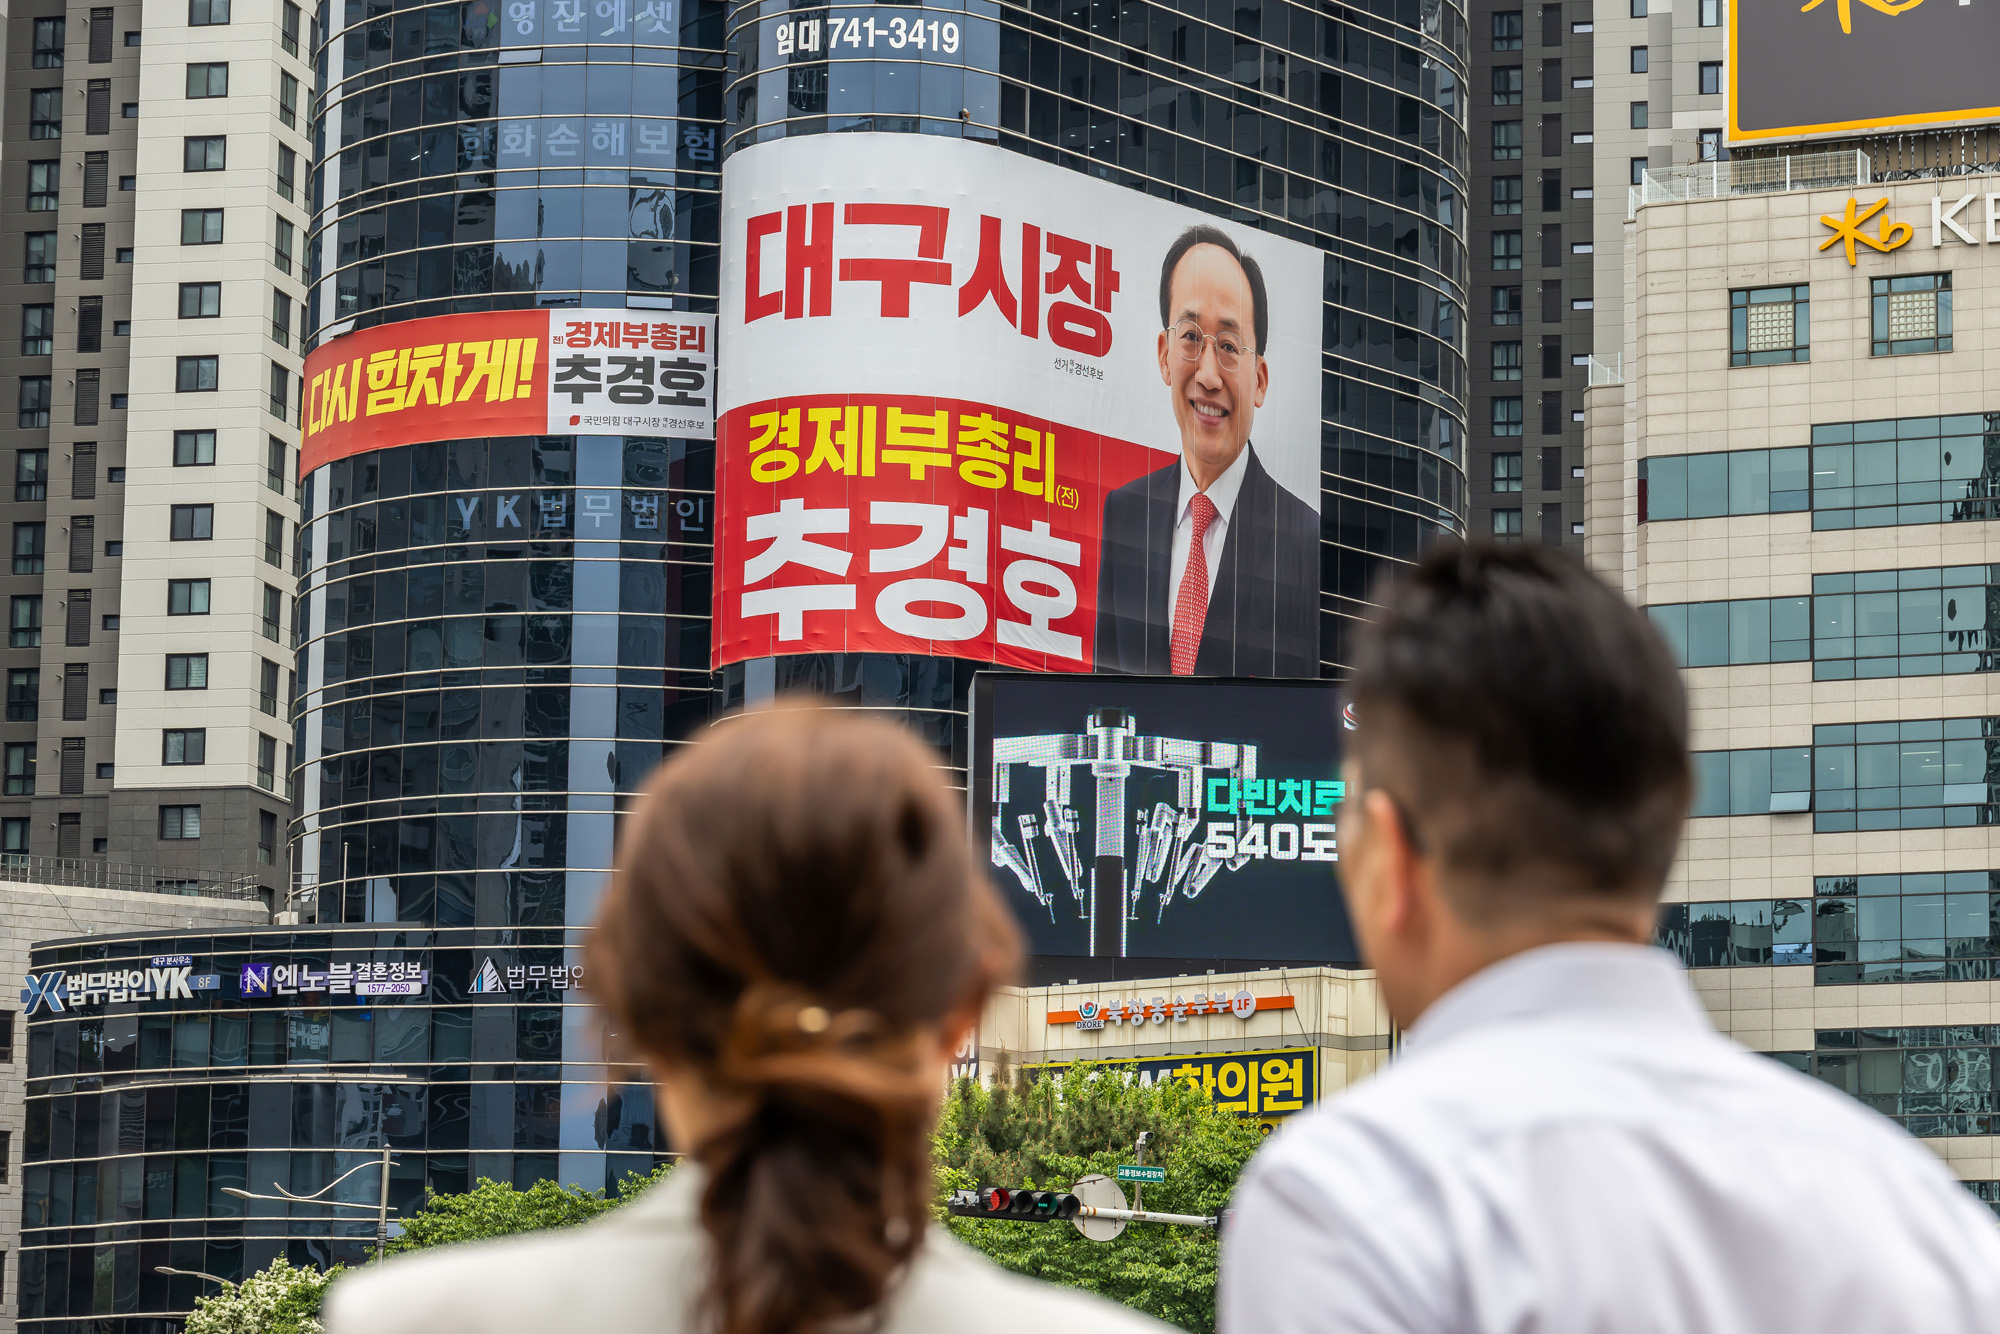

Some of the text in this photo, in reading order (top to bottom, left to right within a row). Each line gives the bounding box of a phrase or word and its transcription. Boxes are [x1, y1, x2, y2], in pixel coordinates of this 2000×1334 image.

[508, 0, 673, 37] 영진에셋
[775, 16, 960, 55] 임대 741-3419
[463, 122, 716, 162] 한화손해보험
[744, 202, 1121, 357] 대구시장
[565, 321, 706, 353] 경제부총리
[308, 357, 364, 438] 다시
[365, 337, 539, 417] 힘차게!
[553, 353, 707, 408] 추경호
[583, 415, 621, 427] 국민의힘
[623, 416, 661, 428] 대구시장
[748, 405, 1080, 511] 경제부총리 (전)
[456, 493, 704, 532] YK 법무법인
[740, 498, 1085, 661] 추경호
[1207, 777, 1356, 817] 다빈치로
[1206, 821, 1339, 862] 540도
[153, 957, 166, 966] 대구
[273, 961, 422, 995] 엔노블 결혼정보
[198, 976, 212, 989] 8F
[367, 983, 411, 994] 1577-2050
[1106, 991, 1250, 1026] 북창동순두부 1F
[1119, 1169, 1163, 1179] 교통정보수집장치
